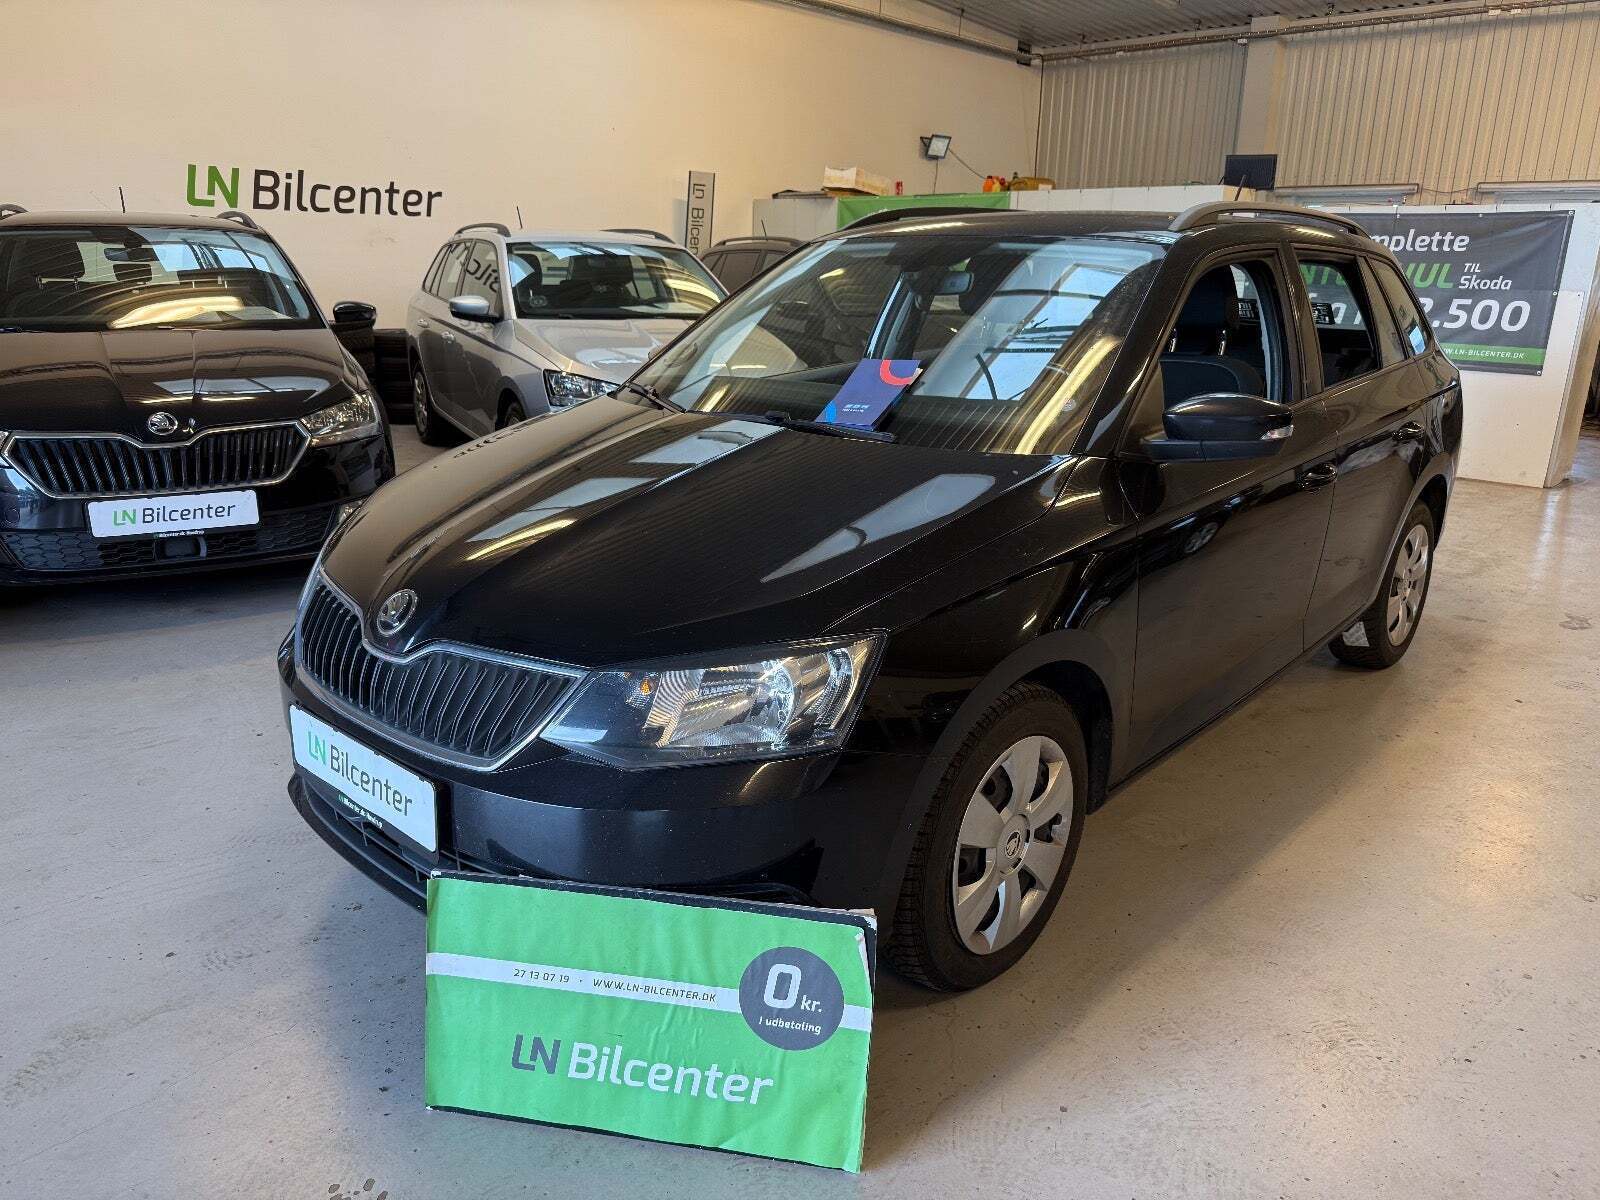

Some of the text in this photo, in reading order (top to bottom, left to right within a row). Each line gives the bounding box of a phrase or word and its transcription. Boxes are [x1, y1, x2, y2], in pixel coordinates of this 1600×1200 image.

[187, 163, 442, 218] LN Bilcenter
[690, 207, 705, 256] Bilcen
[1369, 228, 1470, 252] mplette
[1464, 262, 1481, 273] TIL
[1458, 275, 1513, 291] Skoda
[1443, 347, 1526, 360] W.LN-BILCENTER.DK
[113, 503, 236, 526] LN Bilcenter
[307, 730, 327, 766] LN
[330, 744, 413, 817] Bilcenter
[513, 968, 718, 1002] 27 13 07 19 WWW.LN-BILCENTER.DK
[763, 963, 822, 1013] 0 kr.
[765, 1017, 822, 1036] udbetaling
[511, 1034, 774, 1105] LN Bilcenter
